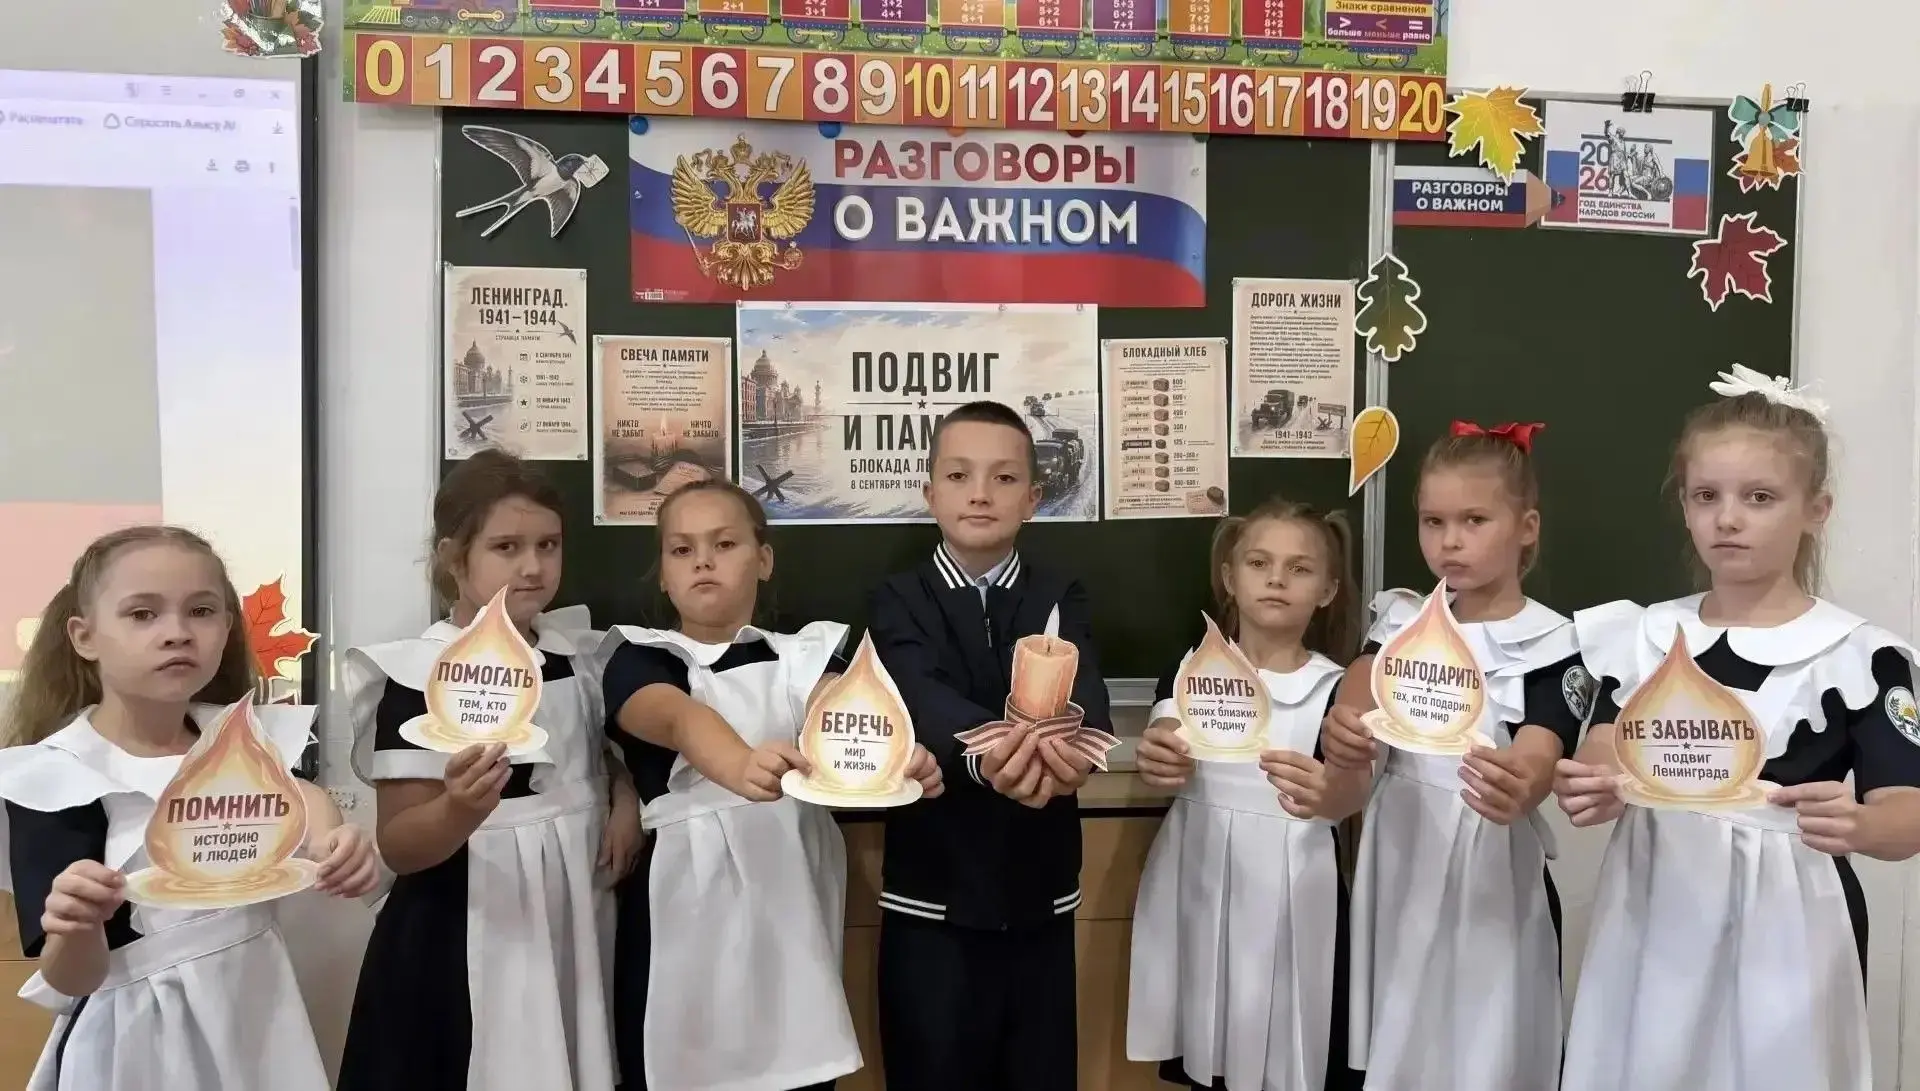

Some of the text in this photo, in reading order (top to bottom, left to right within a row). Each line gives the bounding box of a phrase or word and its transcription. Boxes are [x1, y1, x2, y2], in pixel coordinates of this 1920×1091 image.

[722, 1, 744, 11] 2+1
[805, 7, 827, 17] 3+1
[962, 3, 984, 13] 4+2
[1039, 7, 1060, 16] 5+2
[1335, 1, 1427, 14] Знаки сравнения
[881, 10, 903, 19] 4+1
[1113, 10, 1134, 19] 6+2
[1189, 14, 1210, 24] 7+2
[1264, 10, 1284, 18] 7+3
[1113, 21, 1134, 30] 7+1
[1189, 24, 1210, 33] 8+1
[1264, 19, 1284, 28] 8+2
[1264, 29, 1284, 37] 9+1
[1327, 28, 1363, 38] больше
[1402, 30, 1431, 41] равно
[365, 41, 1444, 133] 0 1 2 3 4 5 6 7 8 9 10 11 12 13 14 15 16 17 18 19 20
[1580, 141, 1610, 166] 20
[833, 139, 1137, 184] РАЗГОВОРЫ
[1579, 166, 1609, 191] 26
[1412, 180, 1509, 197] РАЗГОВОРЫ
[1416, 197, 1504, 212] О ВАЖНОМ
[1579, 199, 1643, 211] ГОД ЕДИНСТВА
[834, 195, 1139, 246] О ВАЖНОМ
[1579, 208, 1656, 221] НАРОДОВ РОССИИ
[471, 287, 568, 308] ЛЕНИНГРАД.
[1251, 292, 1341, 308] ДОРОГА ЖИЗНИ
[620, 348, 709, 363] СВЕЧА ПАМЯТИ
[1123, 345, 1207, 358] БЛОКАДНЫЙ ХЛЕБ
[852, 351, 1000, 397] ПОДВИГ
[617, 419, 640, 429] НИКТО
[690, 420, 712, 429] НИЧТО
[622, 429, 645, 438] ЗАБЫТ
[693, 430, 719, 438] ЗАБЫТО
[844, 414, 943, 452] И ПАМ
[850, 457, 911, 475] БЛОКАДА
[850, 479, 921, 491] 8 СЕНТЯБРЯ 1941
[437, 661, 535, 689] ПОМОГАТЬ
[1384, 656, 1481, 690] БЛАГОДАРИТЬ
[1185, 676, 1255, 698] ЛЮБИТЬ
[458, 698, 507, 711] тем, кто
[1392, 691, 1471, 713] тех, кто подарил
[460, 712, 500, 725] рядом
[1187, 706, 1258, 719] своих близких
[1409, 708, 1450, 724] нам мир
[821, 711, 894, 737] БЕРЕЧЬ
[1201, 721, 1247, 733] и Родину
[1622, 719, 1756, 742] НЕ ЗАБЫВАТЬ
[844, 748, 866, 760] мир
[1663, 751, 1712, 765] подвиг
[834, 760, 877, 772] и жизнь
[1652, 764, 1730, 781] Ленинграда
[166, 793, 291, 824] ПОМНИТЬ
[193, 830, 260, 848] историю
[192, 844, 258, 863] и людей
